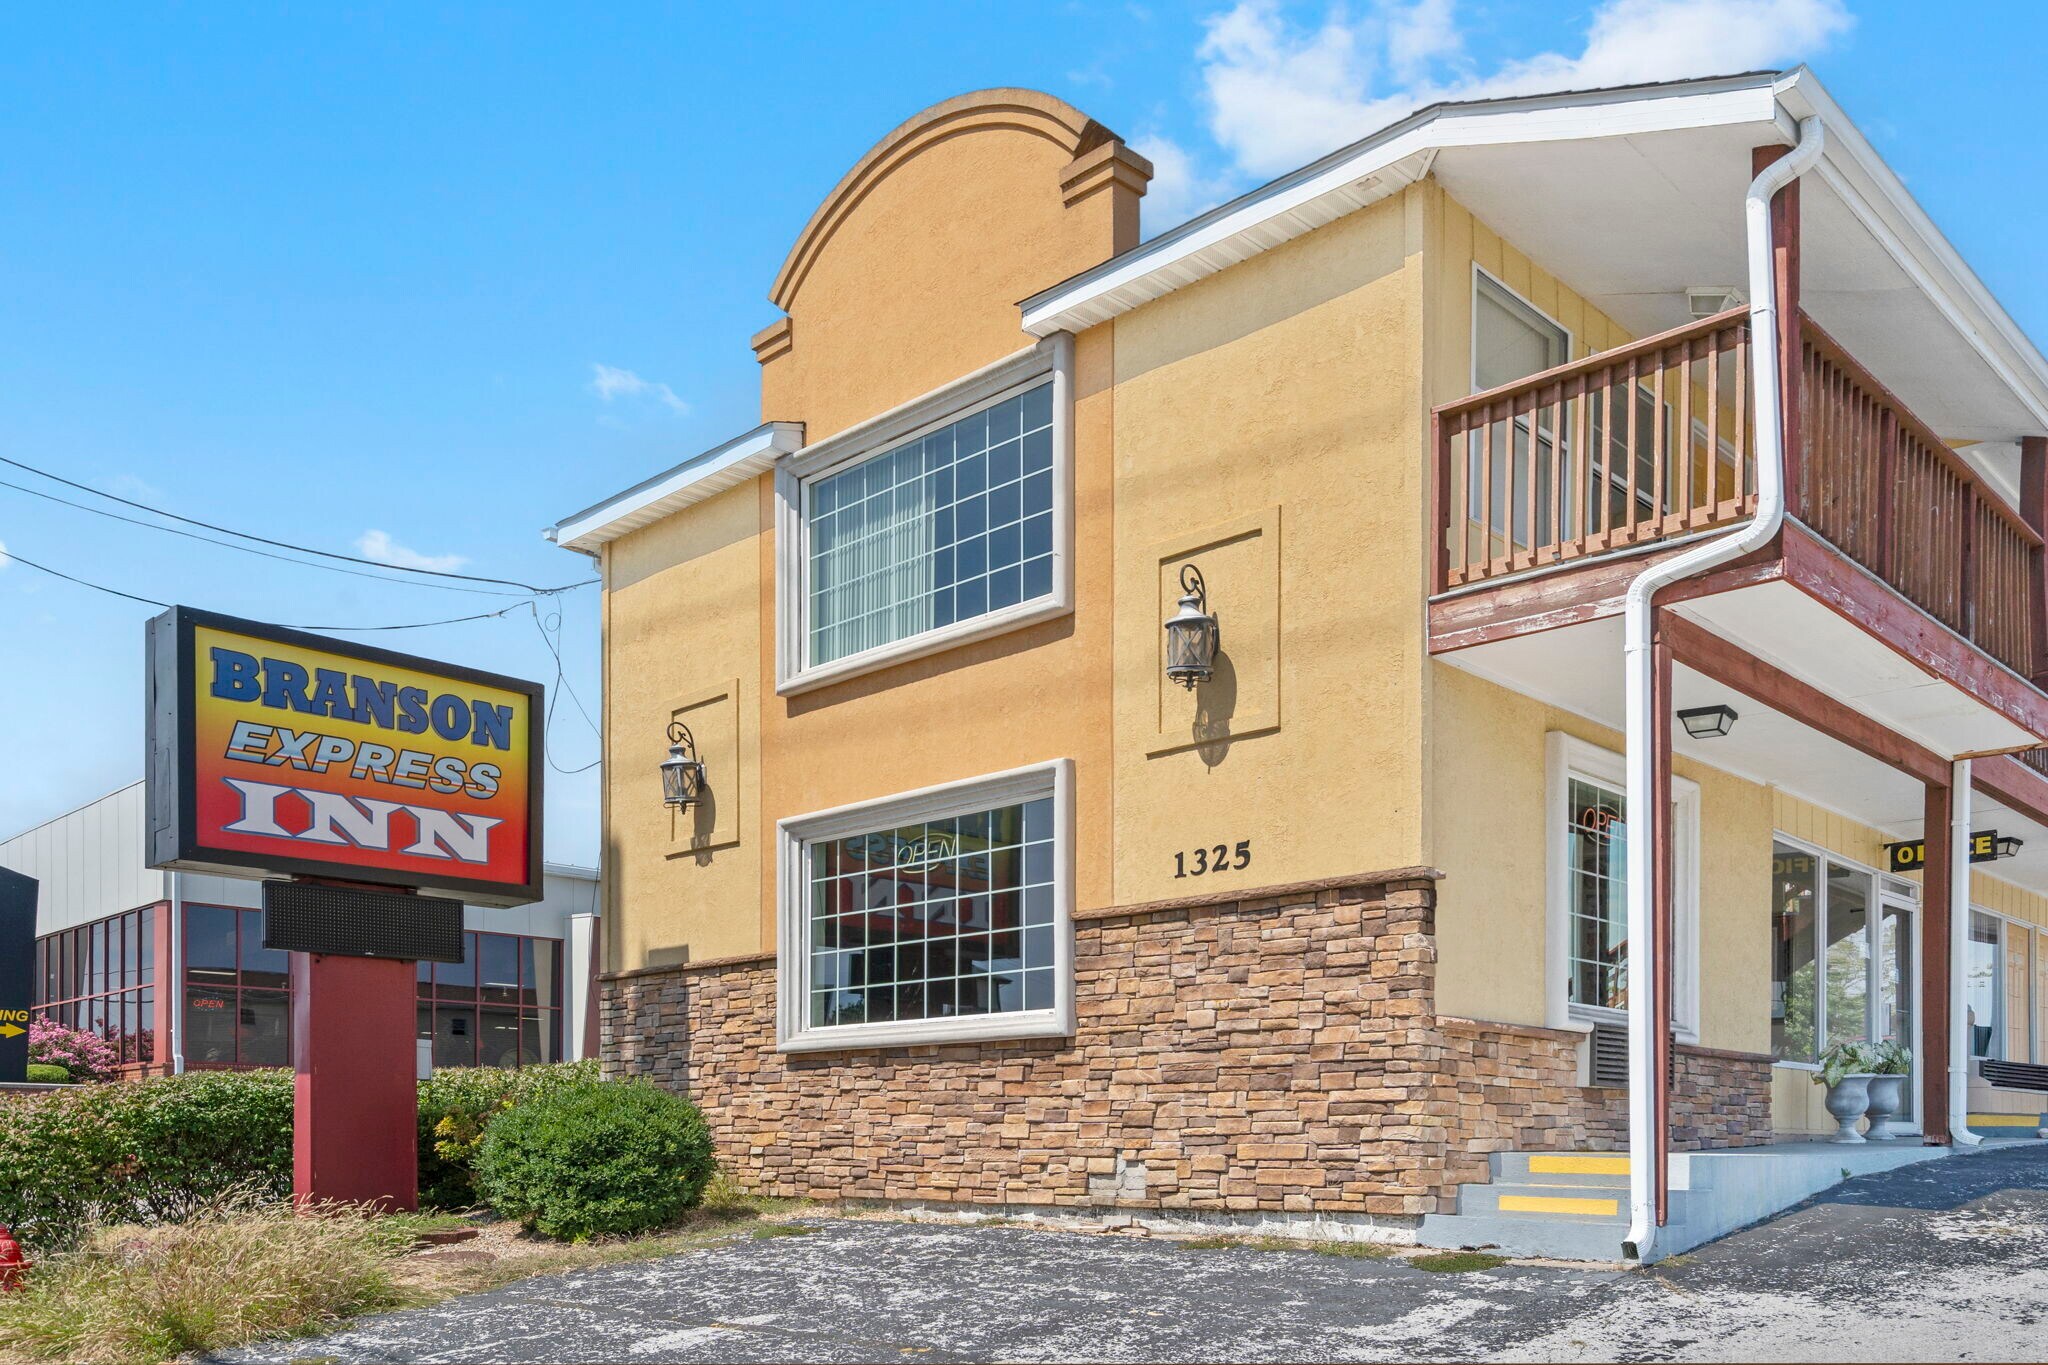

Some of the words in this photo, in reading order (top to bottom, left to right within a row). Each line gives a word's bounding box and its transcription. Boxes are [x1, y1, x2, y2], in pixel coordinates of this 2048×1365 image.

[210, 647, 513, 751] BRANSON
[224, 720, 502, 799] EXPRESS
[220, 777, 505, 865] INN
[1583, 807, 1624, 839] OPE
[897, 837, 956, 868] OPEN
[1174, 839, 1251, 879] 1325
[193, 999, 224, 1009] OPEN
